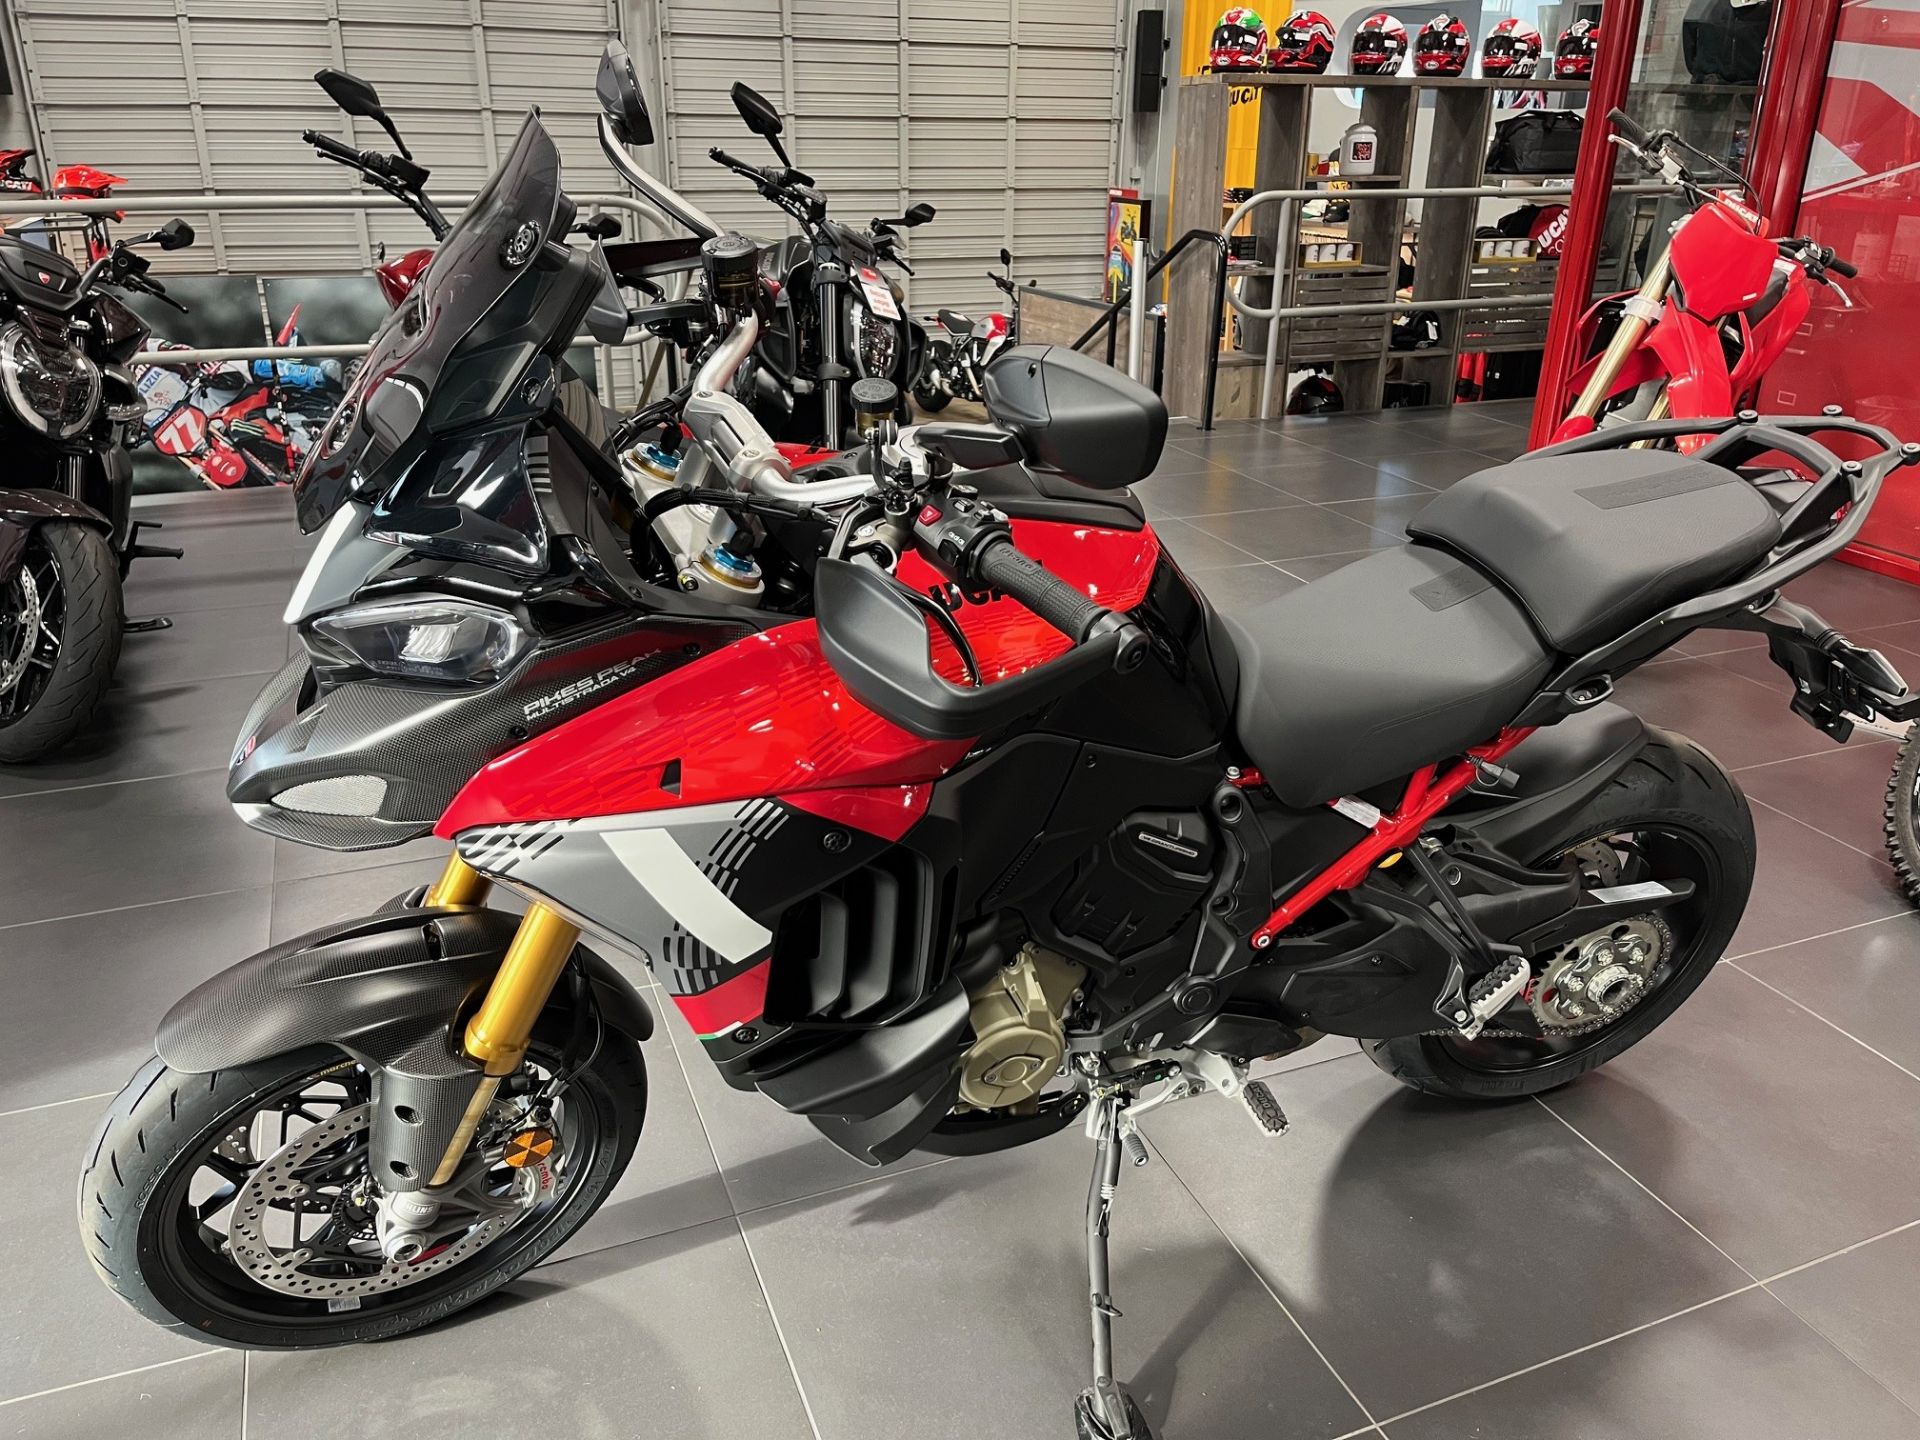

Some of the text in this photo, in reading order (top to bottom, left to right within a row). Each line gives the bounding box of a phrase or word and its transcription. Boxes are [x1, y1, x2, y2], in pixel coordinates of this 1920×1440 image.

[158, 409, 202, 454] 77
[523, 676, 594, 715] PIKES
[526, 666, 637, 721] MULTISTRADA V4
[320, 1059, 358, 1077] marche
[537, 1161, 553, 1191] rembo
